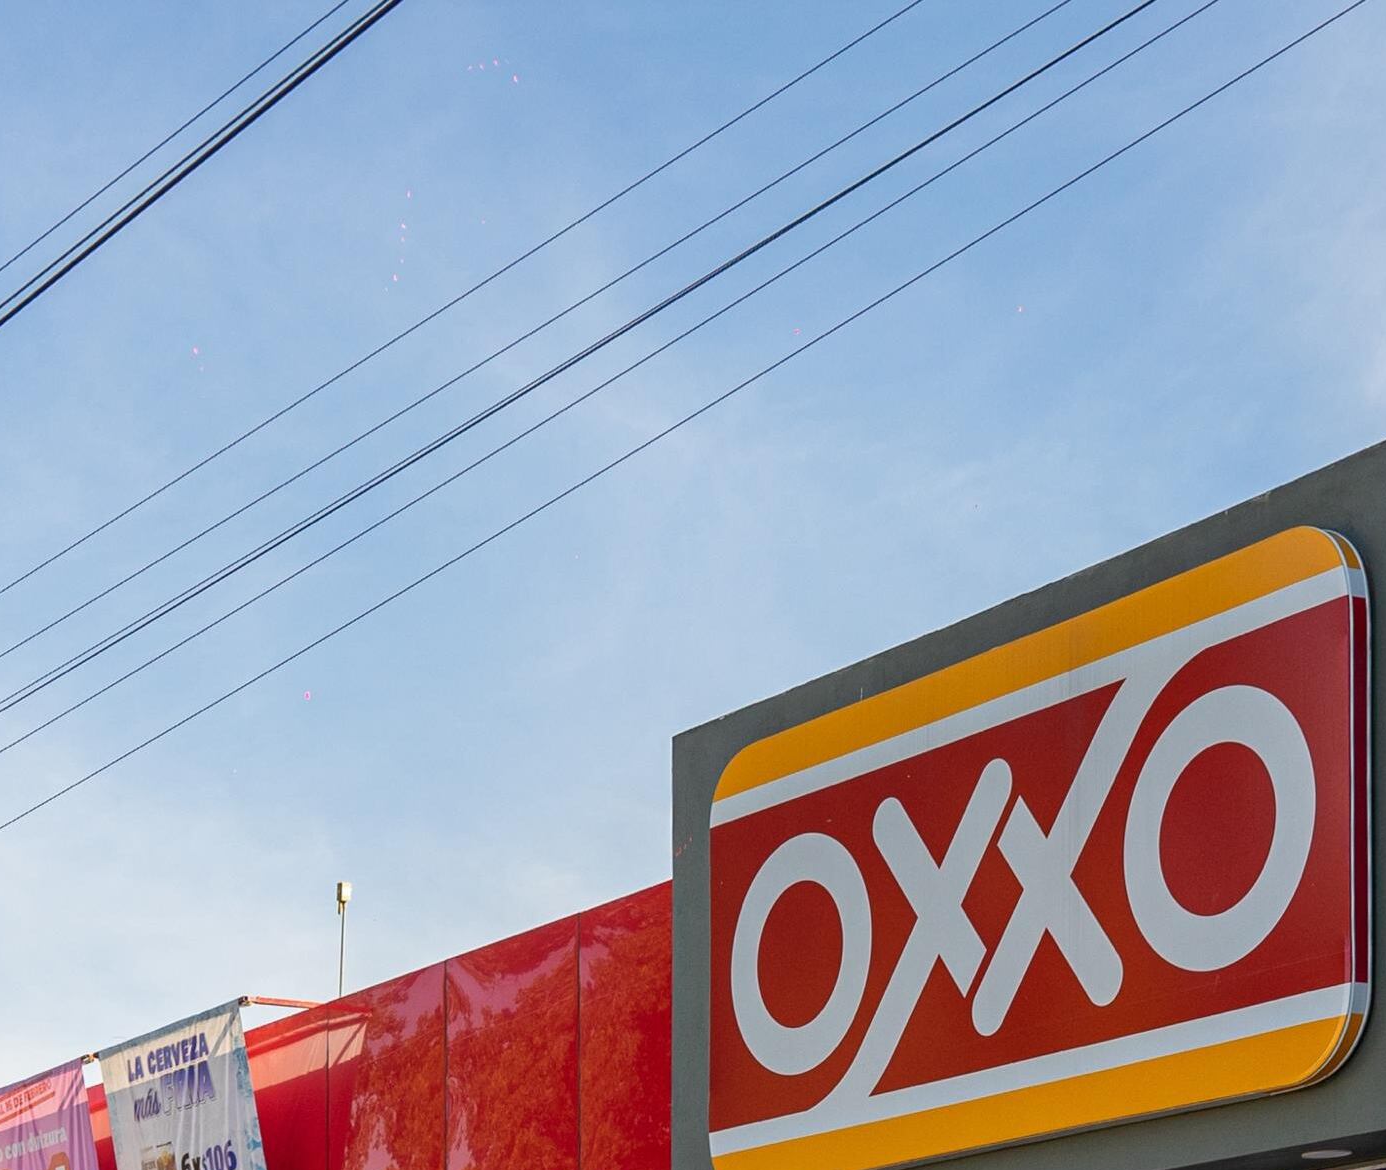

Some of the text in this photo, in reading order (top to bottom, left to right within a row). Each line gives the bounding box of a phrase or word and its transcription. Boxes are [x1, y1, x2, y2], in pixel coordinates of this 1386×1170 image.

[730, 665, 1316, 1100] OXXO
[128, 1033, 209, 1082] LA CERVEZA
